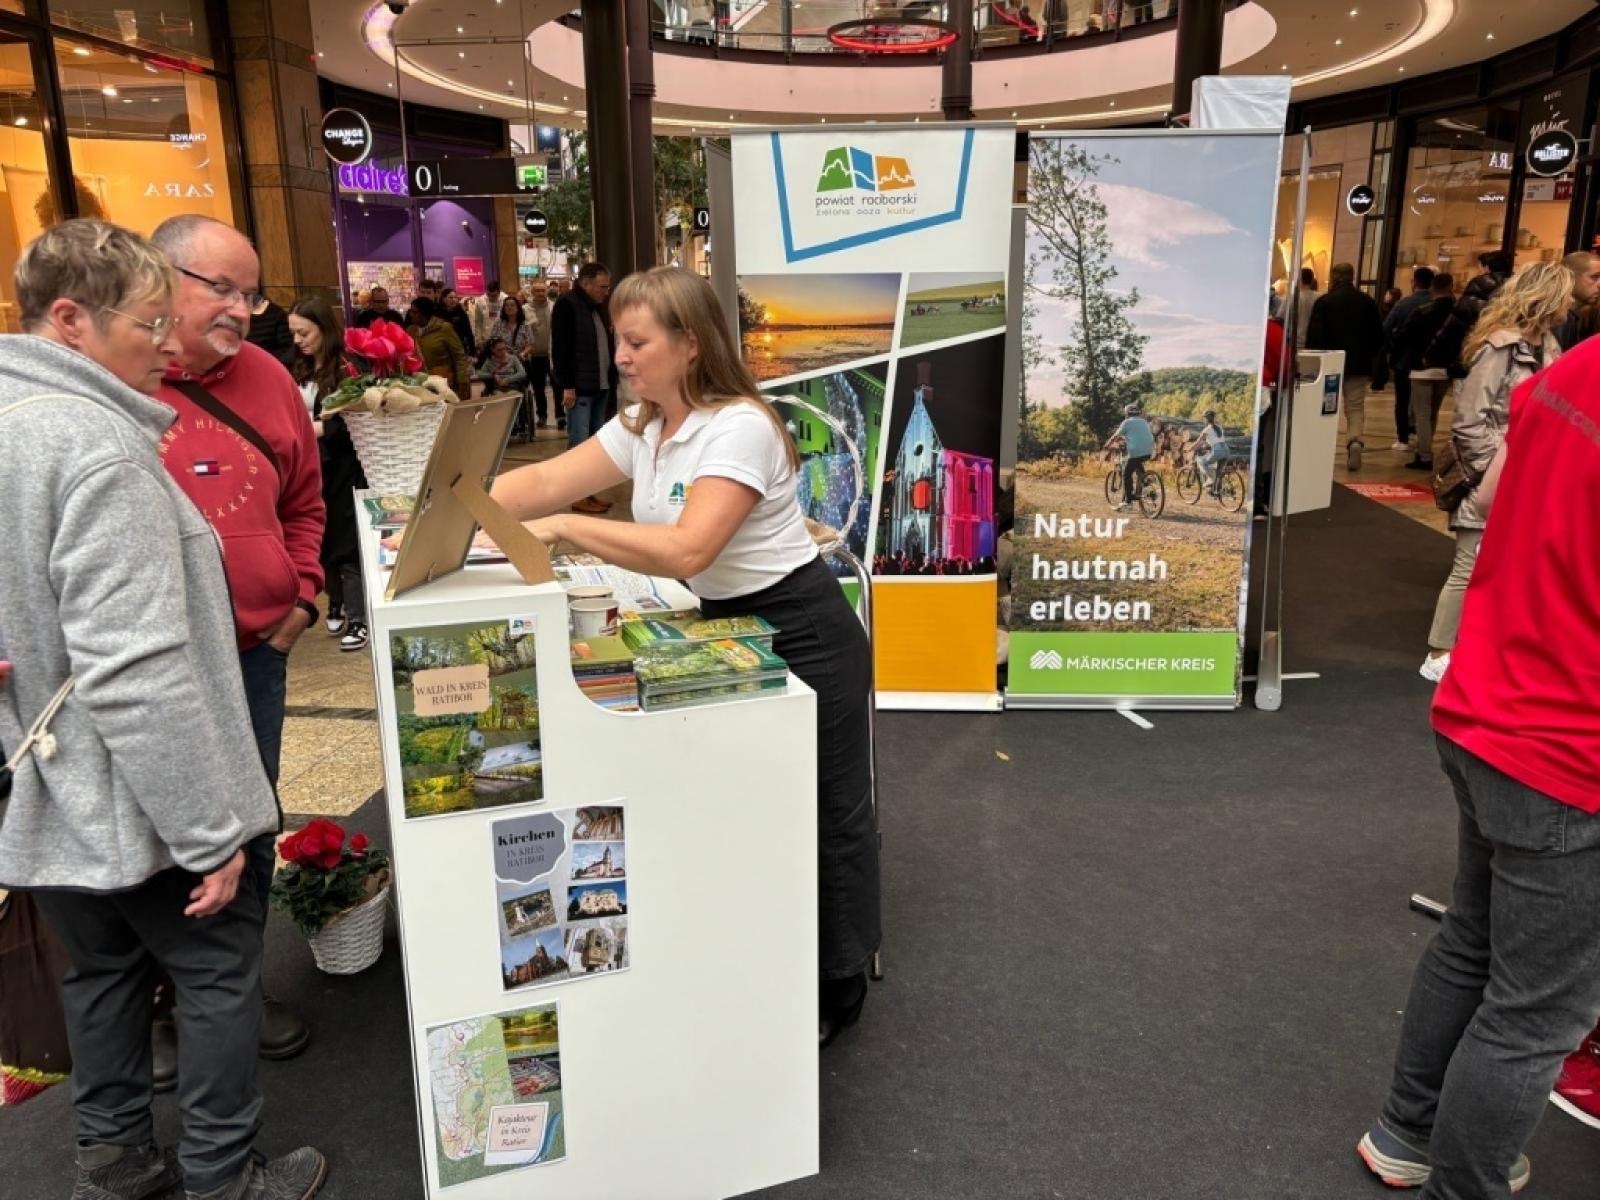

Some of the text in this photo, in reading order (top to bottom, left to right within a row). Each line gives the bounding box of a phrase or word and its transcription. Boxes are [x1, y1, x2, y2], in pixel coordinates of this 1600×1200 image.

[325, 128, 364, 138] CHANGE
[415, 165, 432, 191] 0
[815, 195, 854, 208] powiat
[697, 210, 709, 227] 0
[1034, 513, 1130, 539] Natur
[1032, 553, 1168, 581] hautnah
[1029, 595, 1152, 621] erleben
[1066, 655, 1215, 671] MÄRKISCHER KREIS
[415, 680, 487, 696] WALD IN KREIS
[432, 693, 473, 705] RATIBOR
[498, 830, 555, 846] Kirchen
[507, 850, 517, 858] IN
